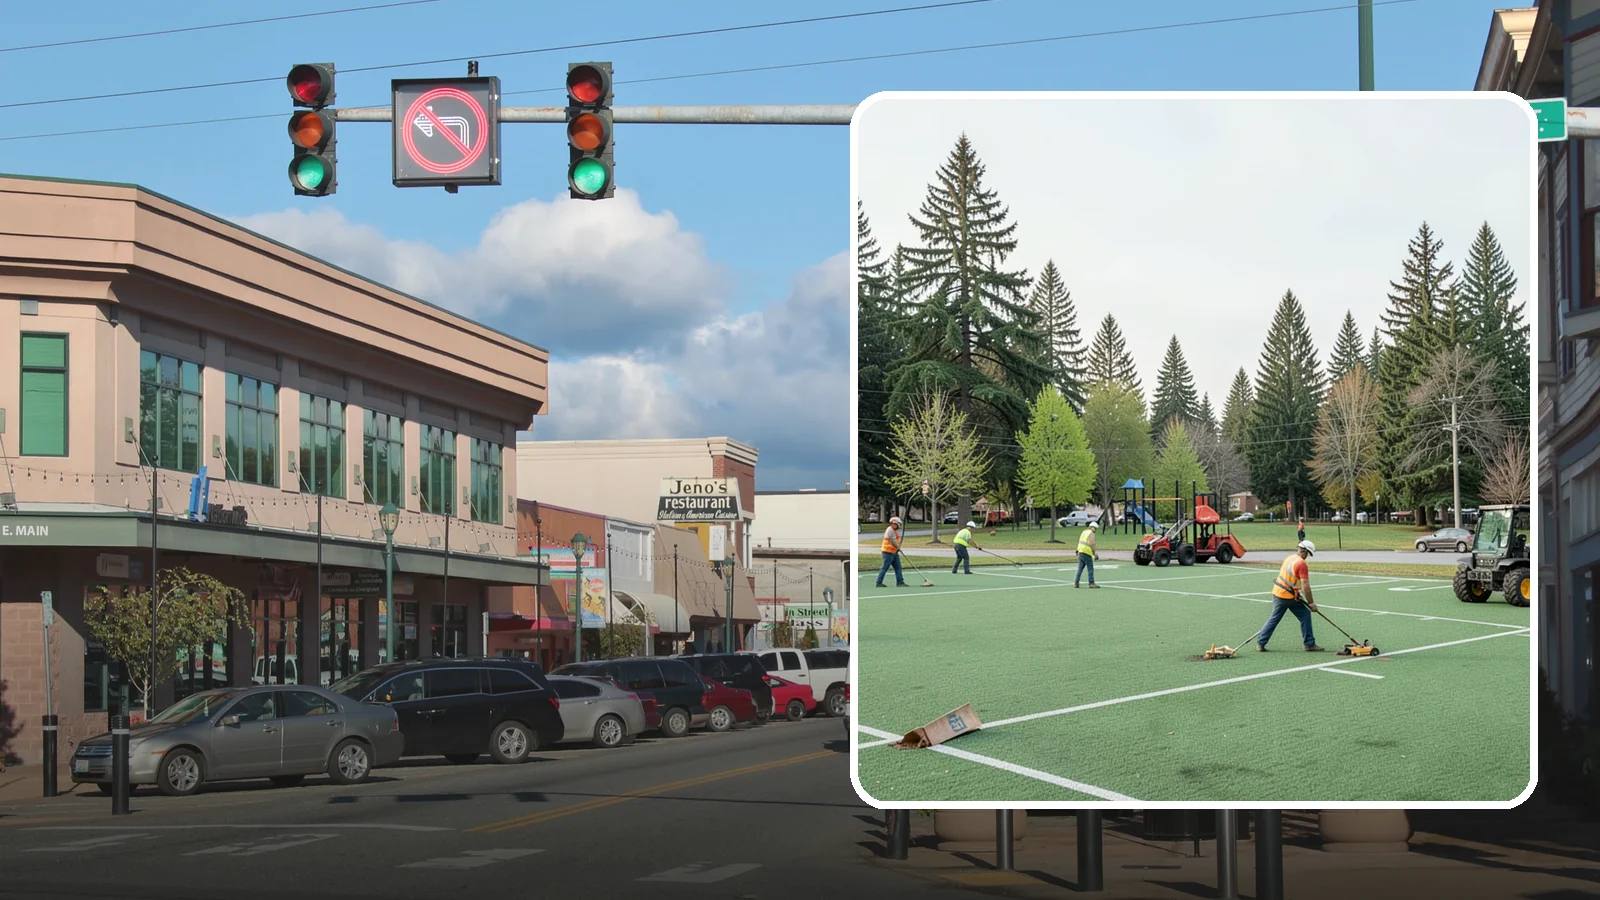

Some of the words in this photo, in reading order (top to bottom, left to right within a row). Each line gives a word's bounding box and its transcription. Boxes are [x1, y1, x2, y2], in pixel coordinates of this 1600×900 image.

[670, 480, 727, 494] Jeno's
[665, 496, 731, 509] restaurant
[658, 509, 682, 520] Italian
[686, 509, 714, 520] American
[715, 509, 738, 519] Cuisine
[15, 525, 49, 536] MAIN
[797, 608, 828, 616] Street
